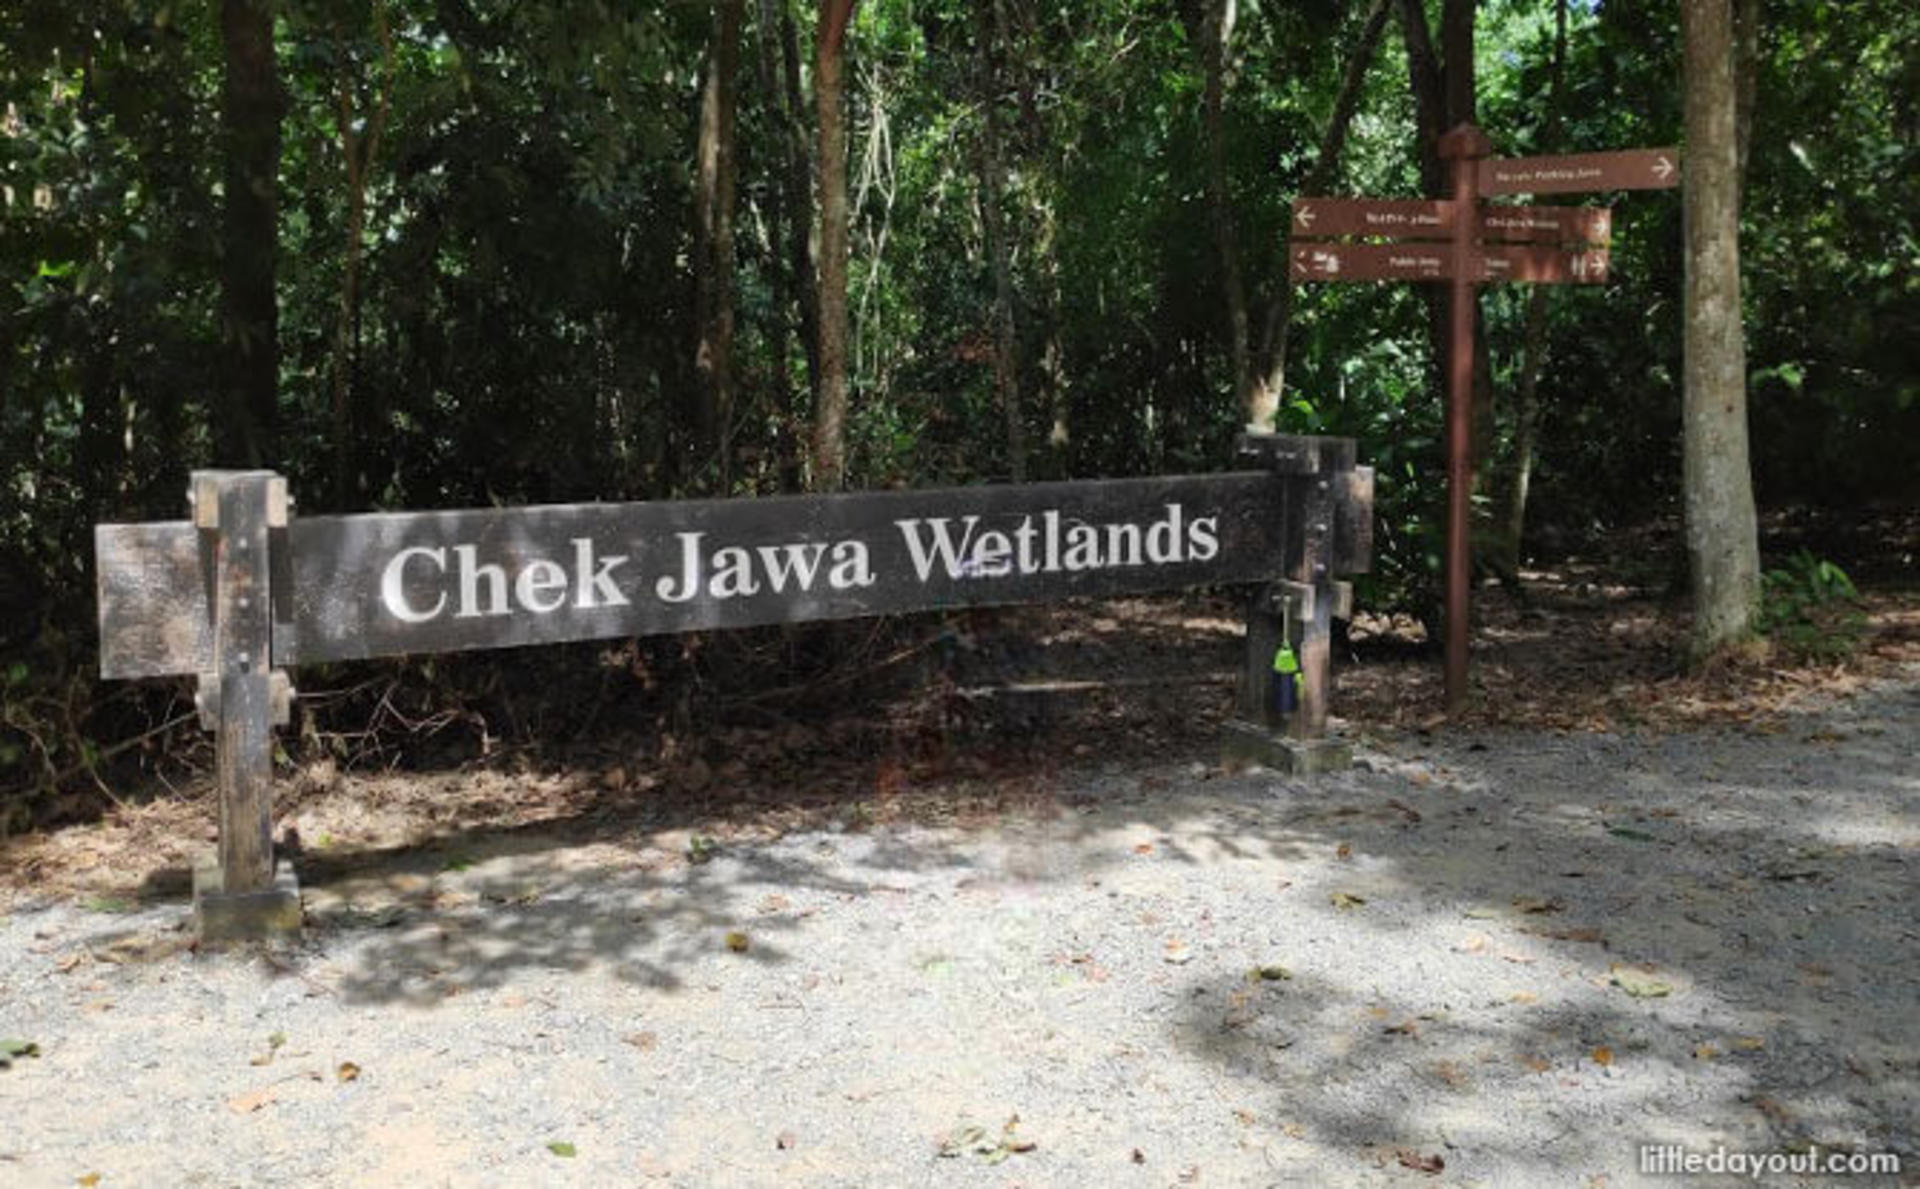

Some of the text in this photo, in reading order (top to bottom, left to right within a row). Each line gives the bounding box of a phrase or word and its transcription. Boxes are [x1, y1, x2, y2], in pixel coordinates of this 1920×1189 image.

[381, 504, 1218, 623] Chek Jawa Wetlands
